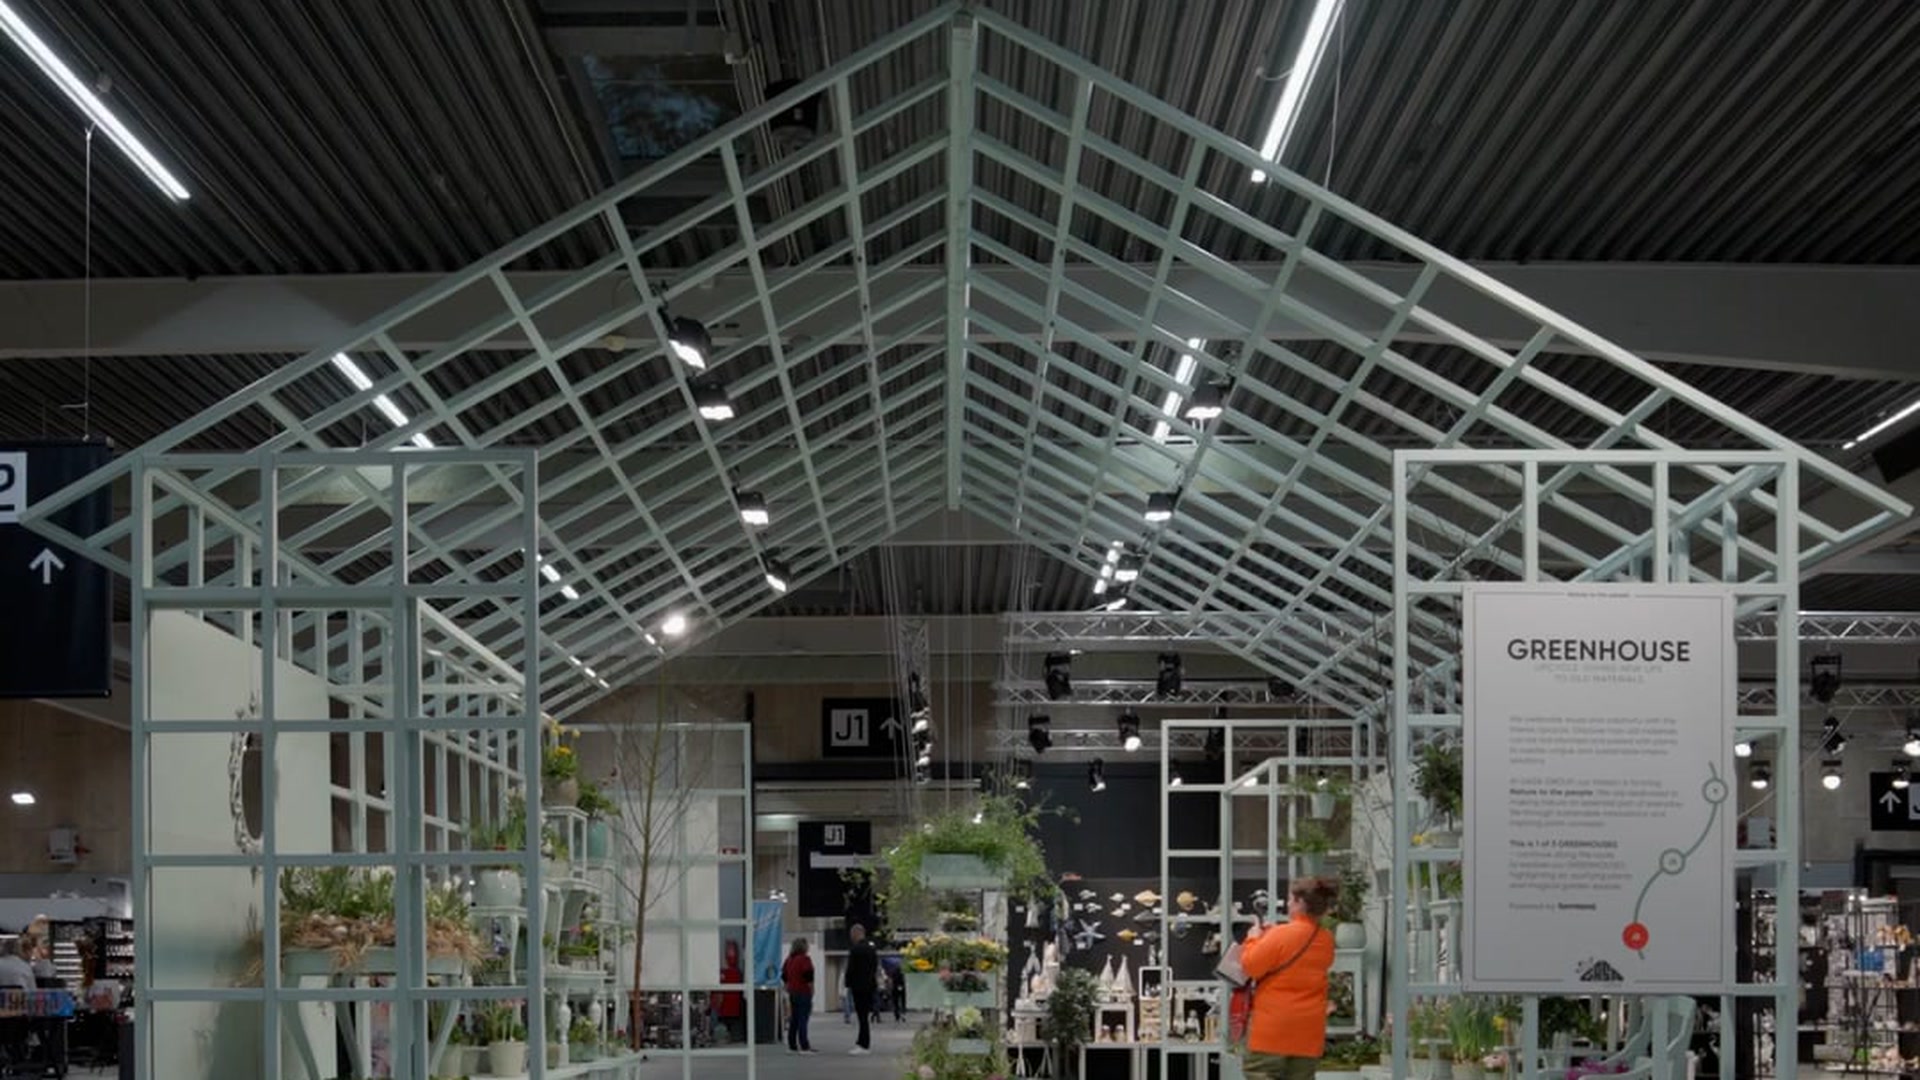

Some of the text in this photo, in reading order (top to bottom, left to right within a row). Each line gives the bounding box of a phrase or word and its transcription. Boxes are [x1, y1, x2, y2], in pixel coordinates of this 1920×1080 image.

[1507, 638, 1691, 662] GREENHOUSE
[835, 713, 864, 741] J1
[825, 828, 843, 843] J1
